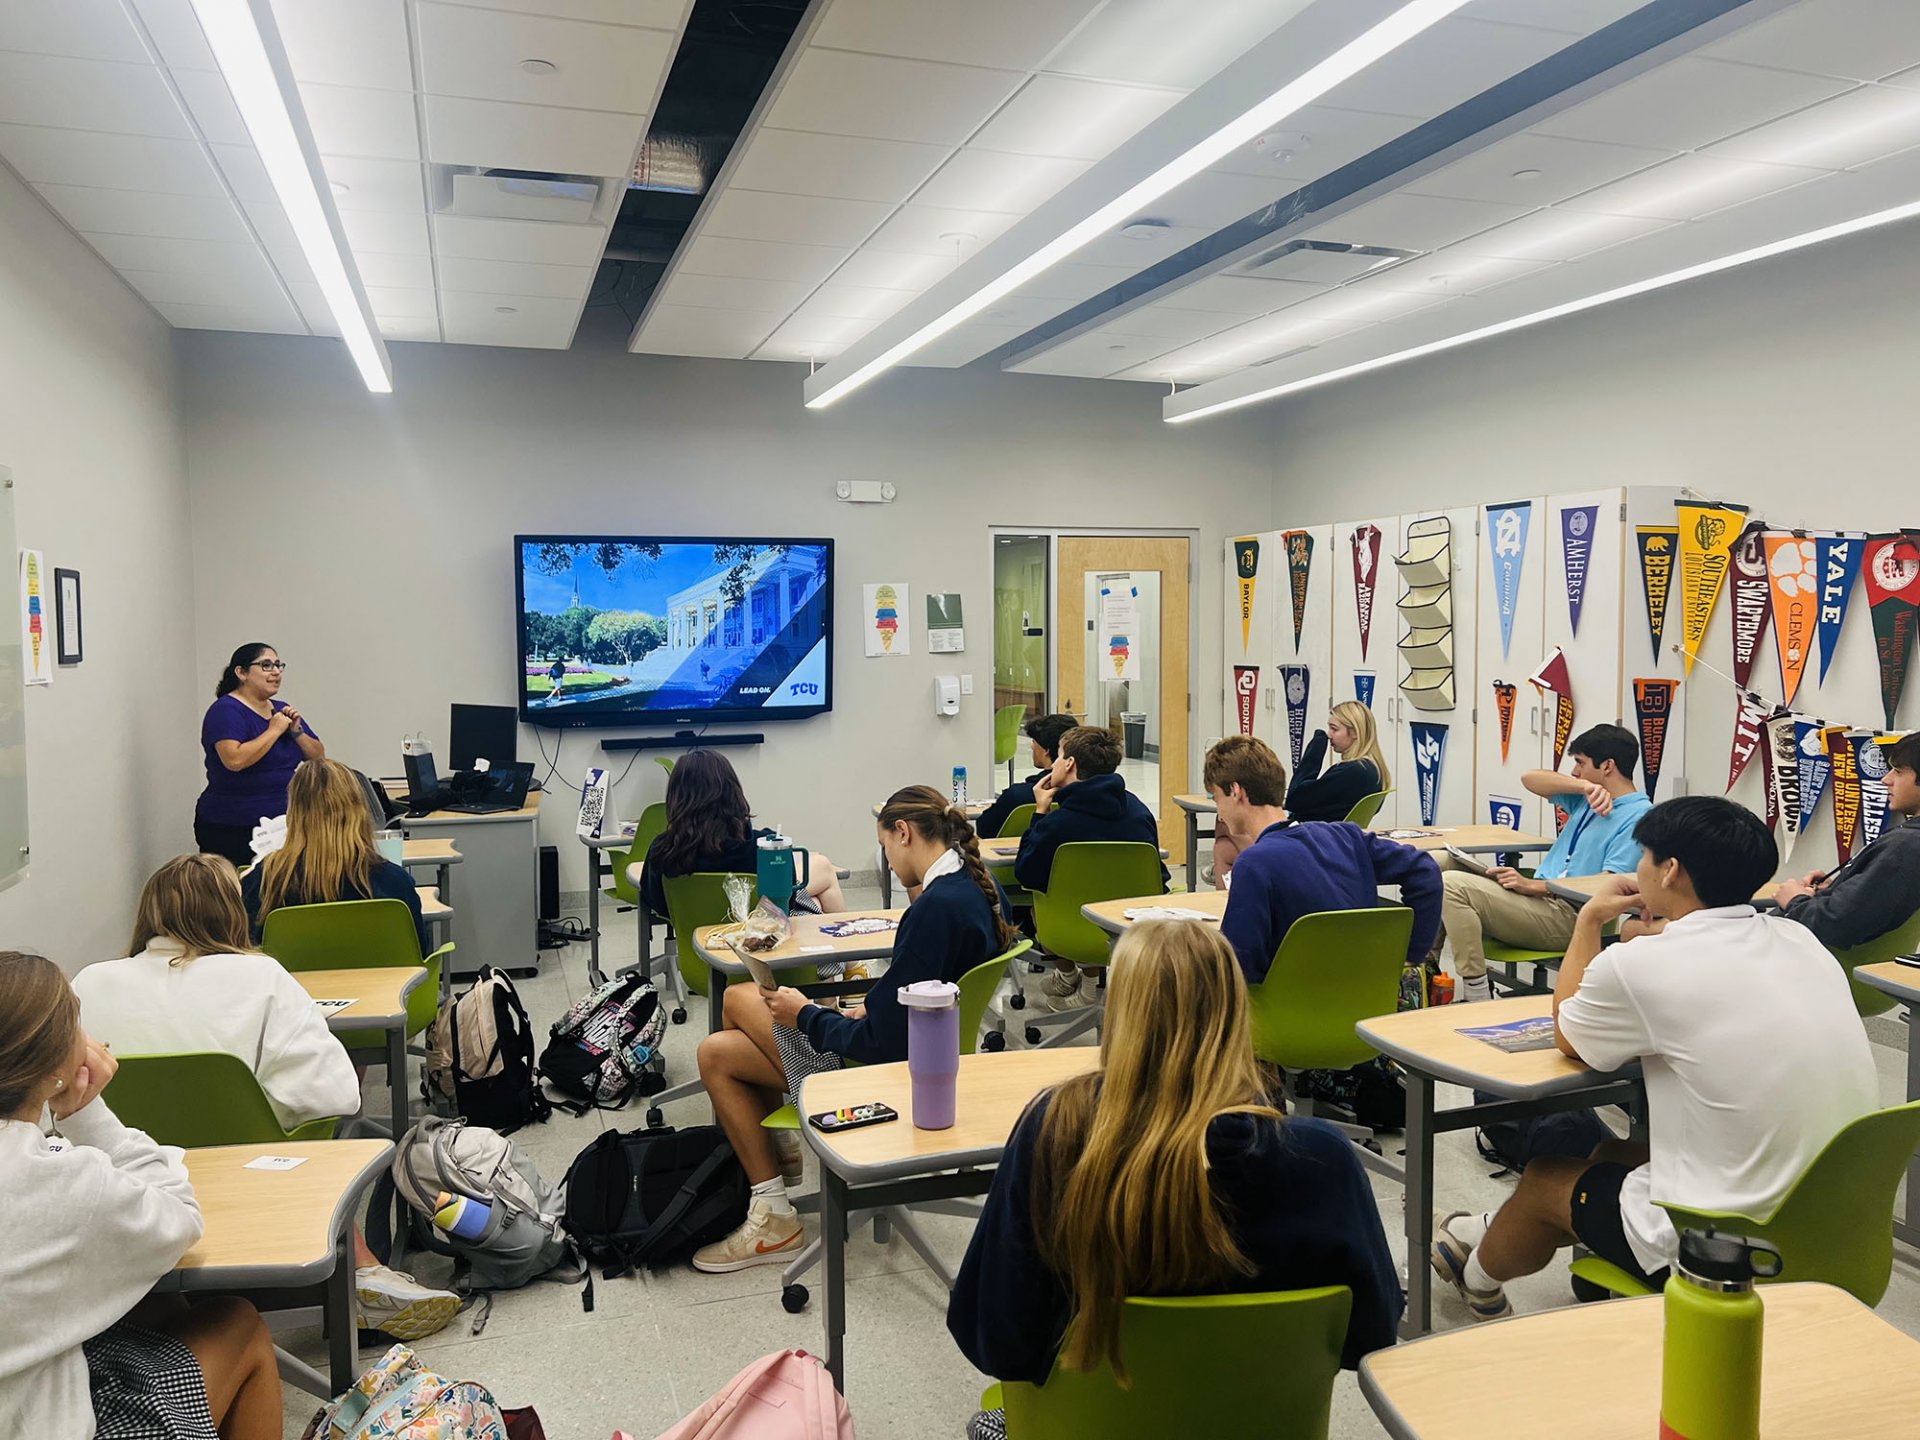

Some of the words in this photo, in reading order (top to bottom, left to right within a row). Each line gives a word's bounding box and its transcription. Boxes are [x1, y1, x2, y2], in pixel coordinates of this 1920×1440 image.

[1567, 538, 1588, 604] AMHERST
[1644, 555, 1671, 636] BERKELEY
[1685, 552, 1703, 593] LOUISIANA
[1692, 554, 1727, 642] SOUTHEASTERN
[1821, 542, 1848, 624] YALE
[1737, 580, 1769, 664] SWARTHMORE
[790, 682, 819, 697] TCU
[1295, 708, 1304, 735] HIGH
[1652, 717, 1665, 773] BUCKNELL
[1833, 753, 1846, 779] NEW
[1834, 781, 1844, 832] ORLEANS
[1843, 783, 1860, 848] UNIVERSITY
